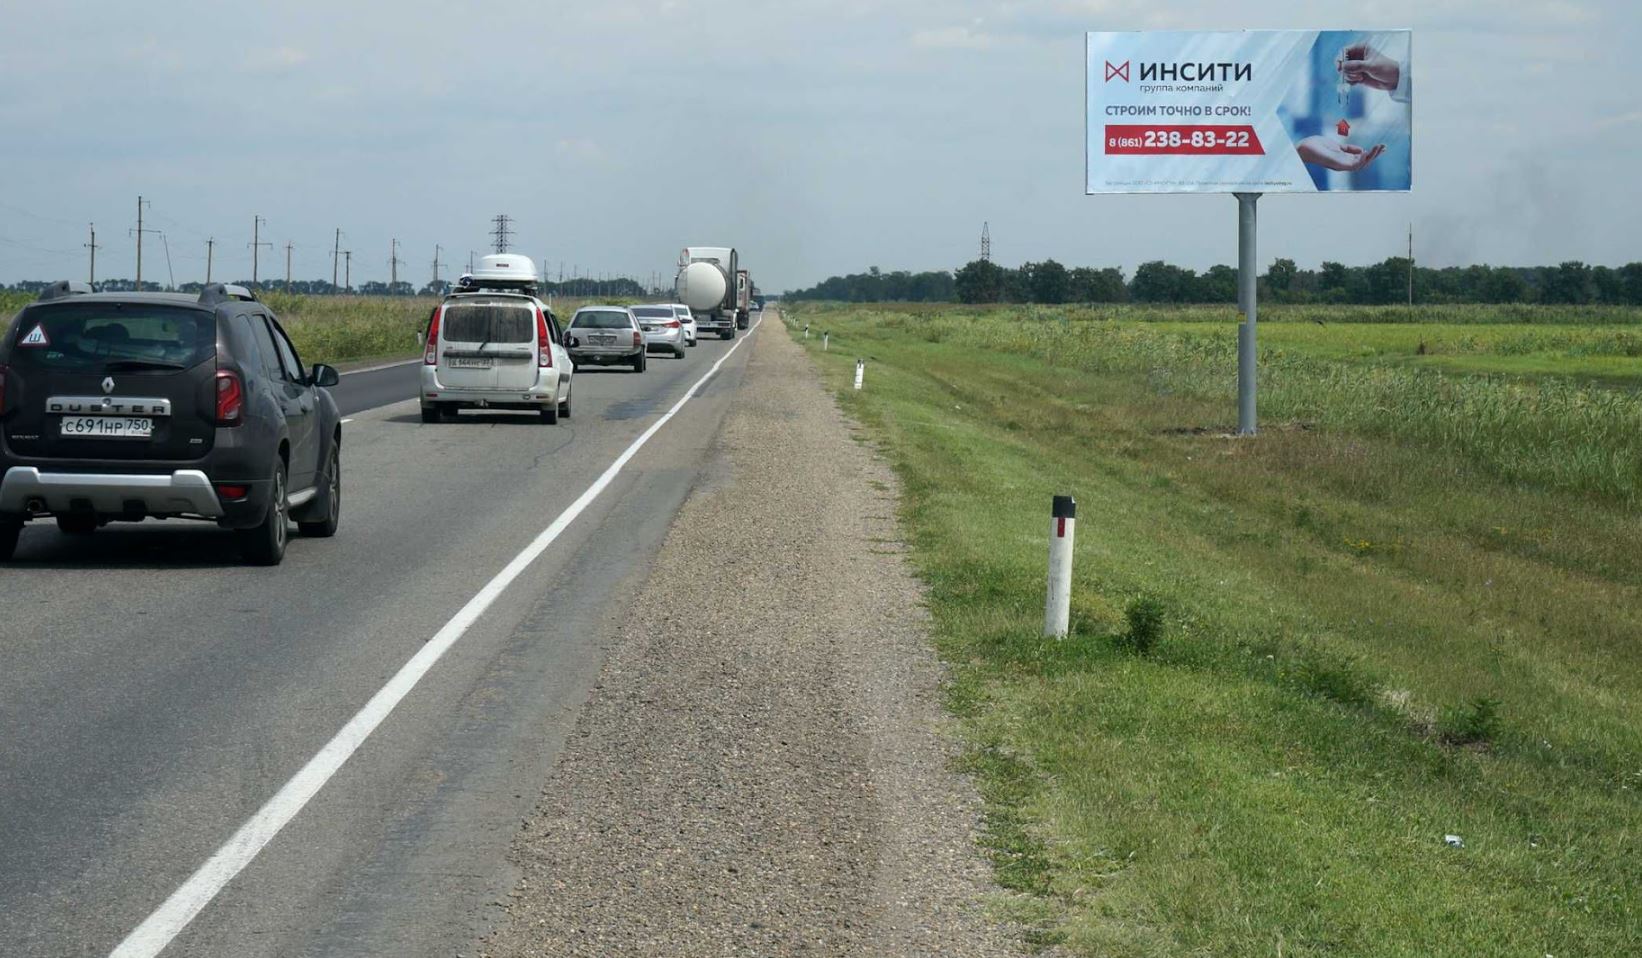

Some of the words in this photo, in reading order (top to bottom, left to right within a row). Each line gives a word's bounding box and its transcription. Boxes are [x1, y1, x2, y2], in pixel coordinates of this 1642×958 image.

[1140, 62, 1252, 81] ИНСИТИ
[1140, 84, 1173, 92] группа
[1176, 84, 1224, 92] компаний
[1105, 105, 1156, 116] СТРОИМ
[1159, 106, 1202, 116] ТОЧНО
[1205, 106, 1212, 116] В
[1215, 106, 1252, 117] СРОК!
[1109, 138, 1116, 147] 8
[1118, 137, 1143, 149] (861)
[1144, 131, 1249, 148] 238-83-22
[50, 403, 165, 413] DUSTER
